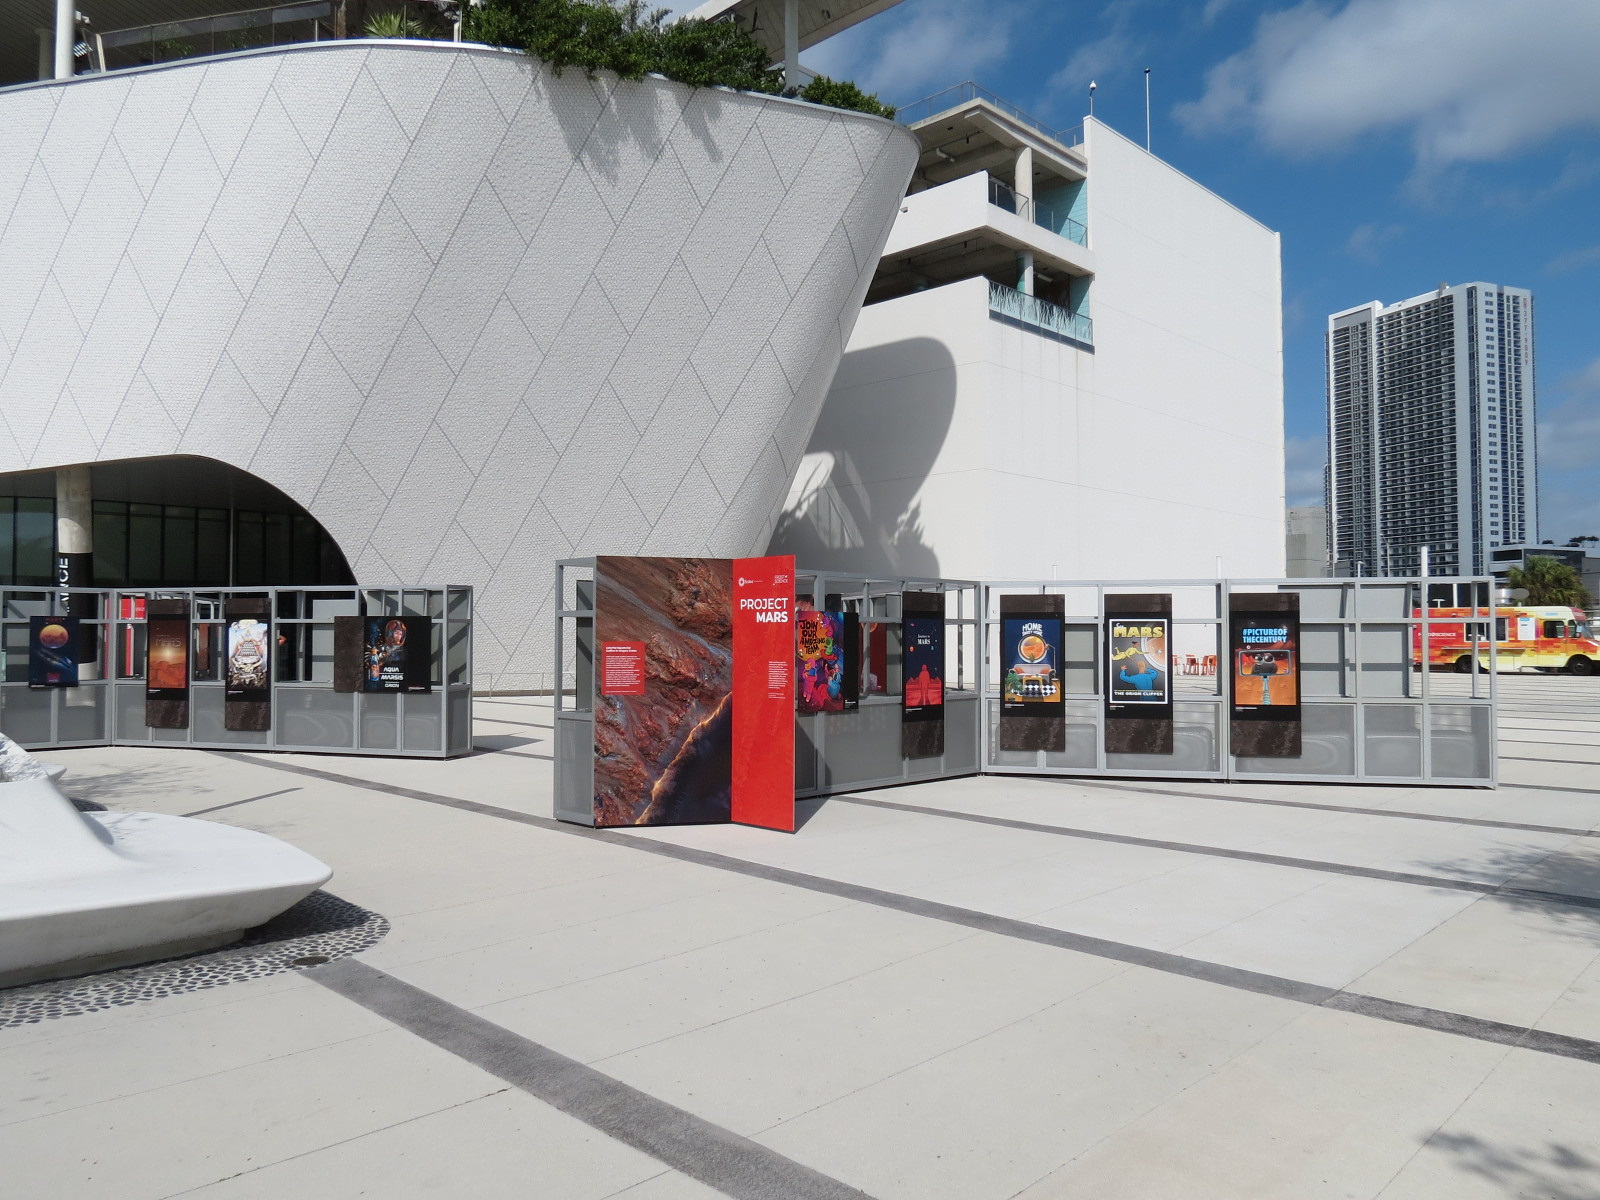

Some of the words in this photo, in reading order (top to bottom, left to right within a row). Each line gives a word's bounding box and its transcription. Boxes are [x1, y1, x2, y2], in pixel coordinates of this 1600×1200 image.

[740, 597, 789, 610] PROJECT
[756, 611, 789, 623] MARS
[799, 619, 818, 632] JOIN
[1022, 622, 1043, 632] HOME
[802, 630, 817, 638] OUR
[1113, 626, 1164, 638] MARS
[1242, 628, 1288, 636] #PICTUREOF
[804, 645, 819, 655] TEAM
